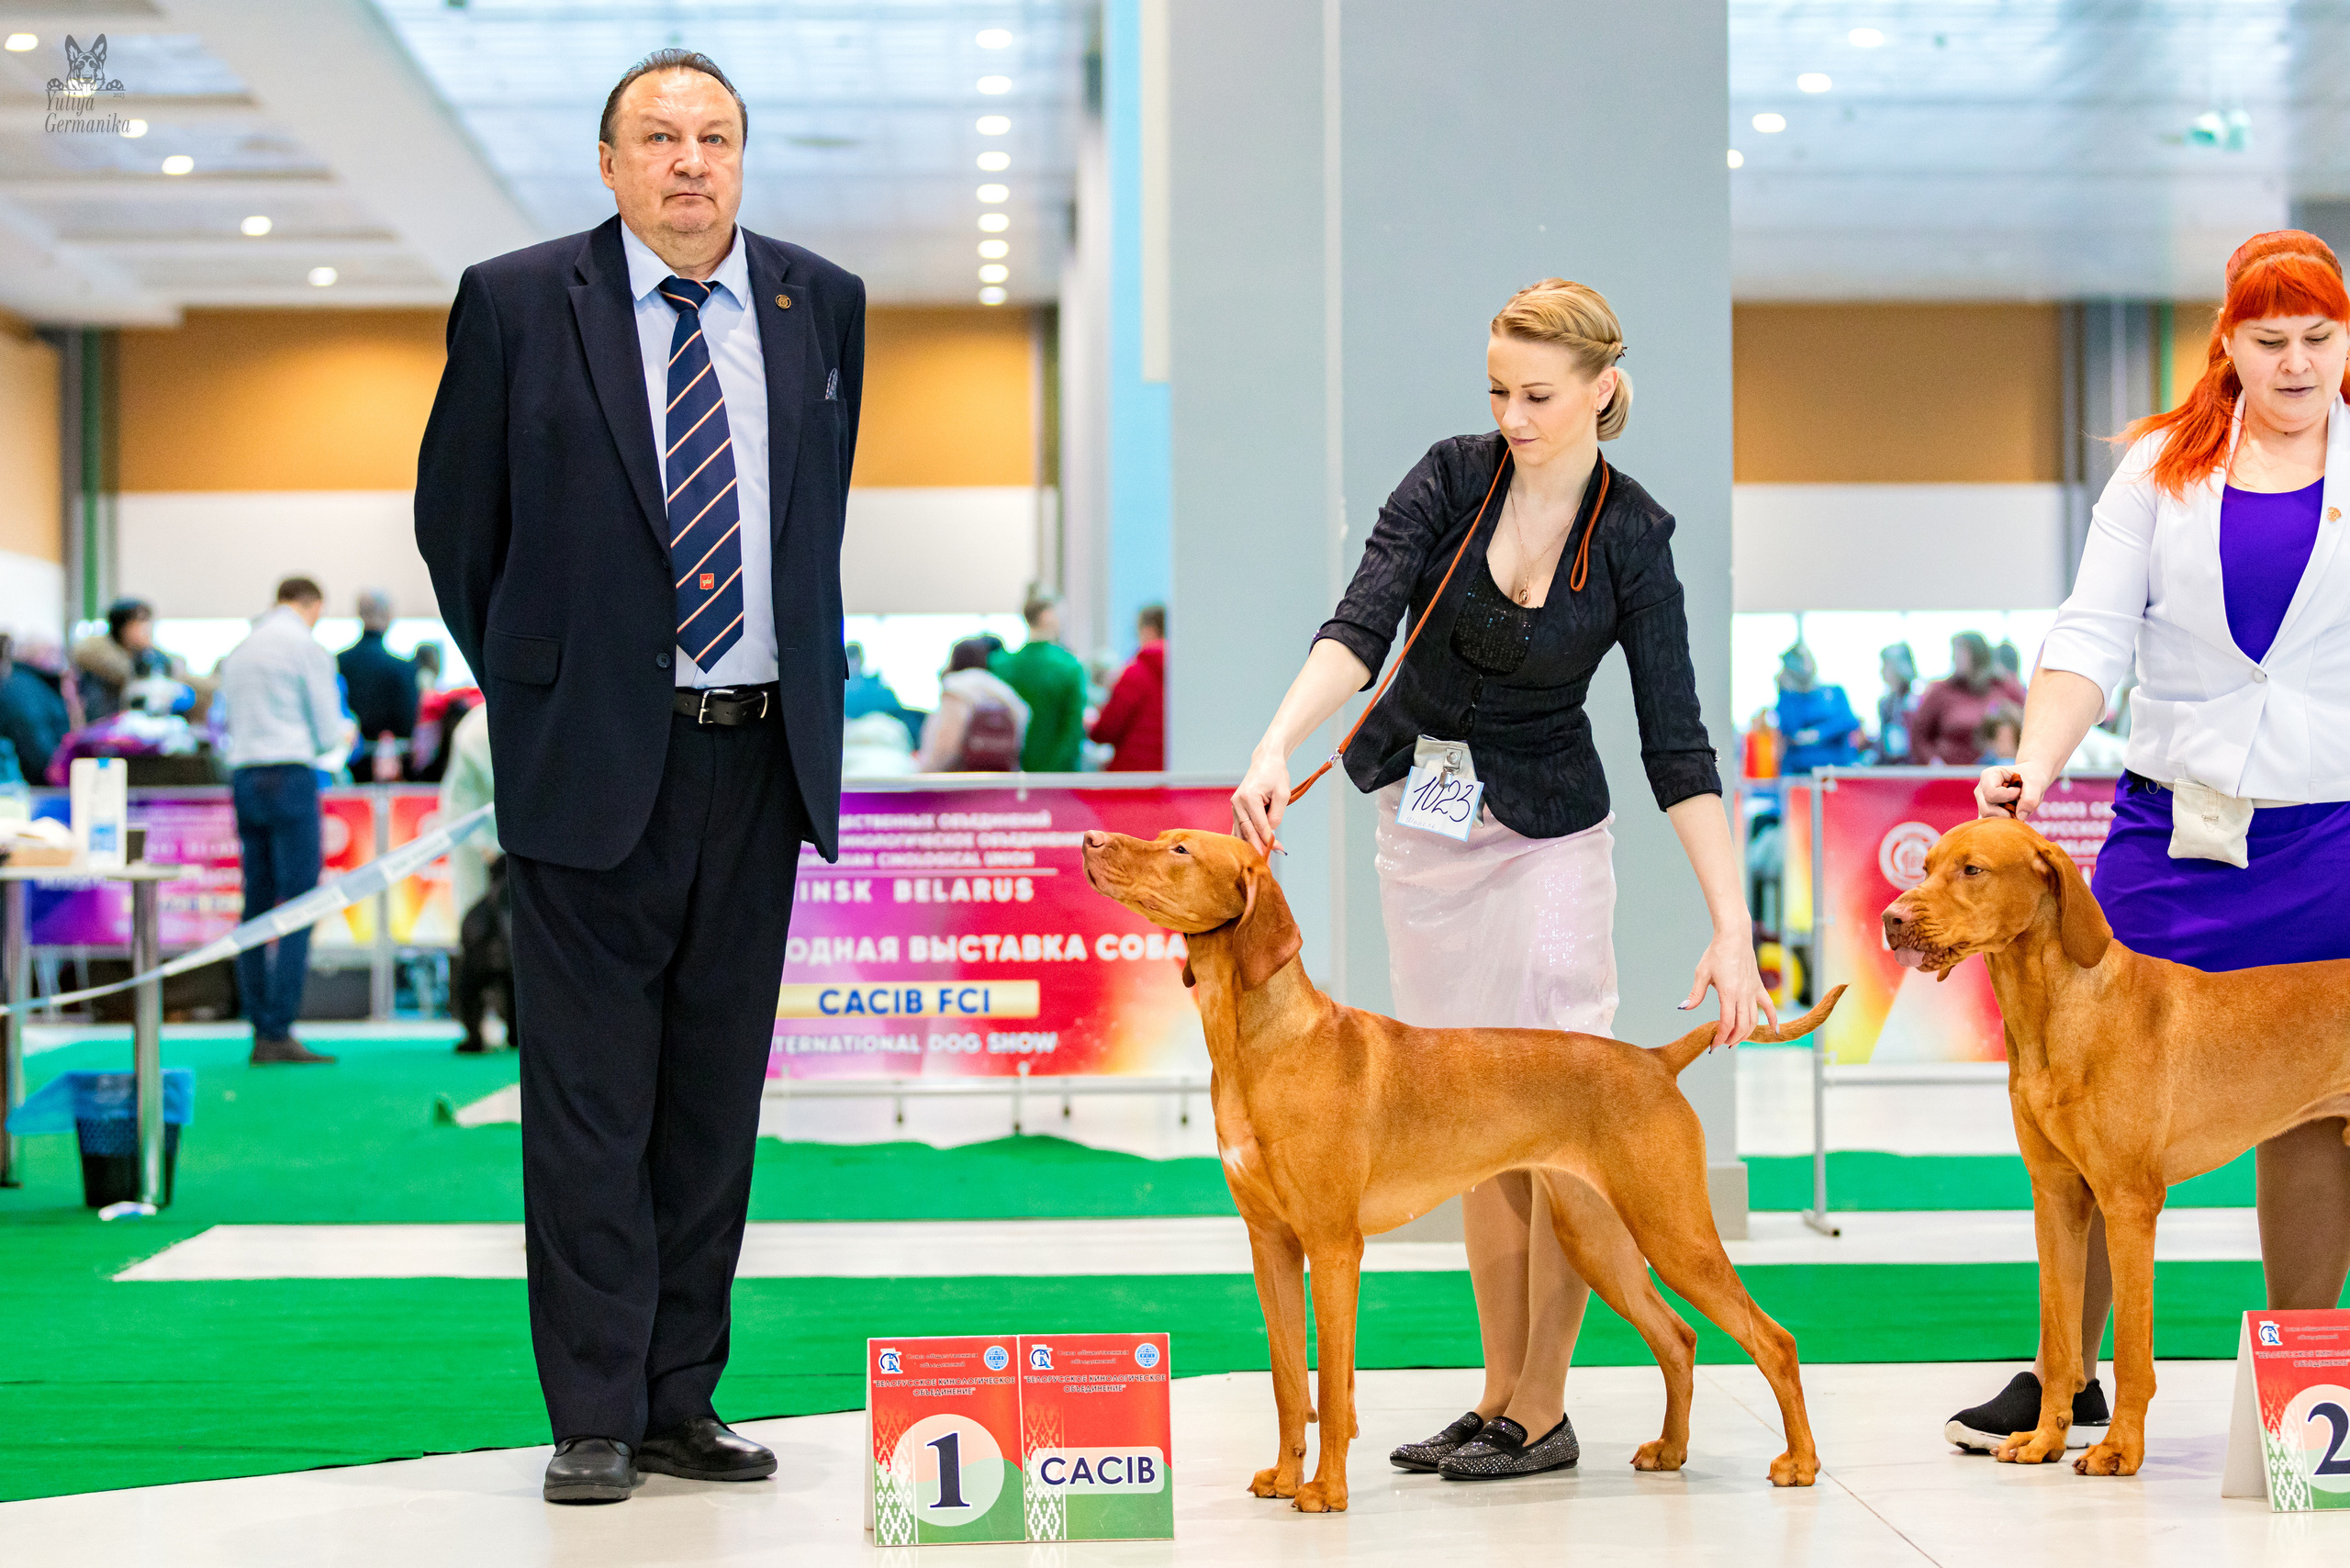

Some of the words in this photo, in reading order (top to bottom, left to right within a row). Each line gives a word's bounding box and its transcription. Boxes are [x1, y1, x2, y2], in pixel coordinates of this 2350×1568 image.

[1412, 776, 1473, 823] 1023
[800, 879, 872, 903] INSK
[893, 877, 1034, 902] BELARUS
[788, 935, 900, 967] ОДНАЯ
[909, 934, 1087, 963] ВЫСТАВКА
[1096, 934, 1188, 961] СОБА
[819, 988, 923, 1015] CACIB
[938, 988, 990, 1014] FCI
[772, 1034, 921, 1056] TERNATIONAL
[928, 1034, 981, 1054] DOG
[988, 1032, 1058, 1054] SHOW
[938, 1376, 1016, 1385] КИНОЛОГИЧЕСКОЕ
[1089, 1373, 1167, 1383] КИНОЛОГИЧЕСКОЕ
[2307, 1402, 2350, 1475] 2
[926, 1432, 970, 1508] 1
[1041, 1456, 1156, 1485] CACIB
